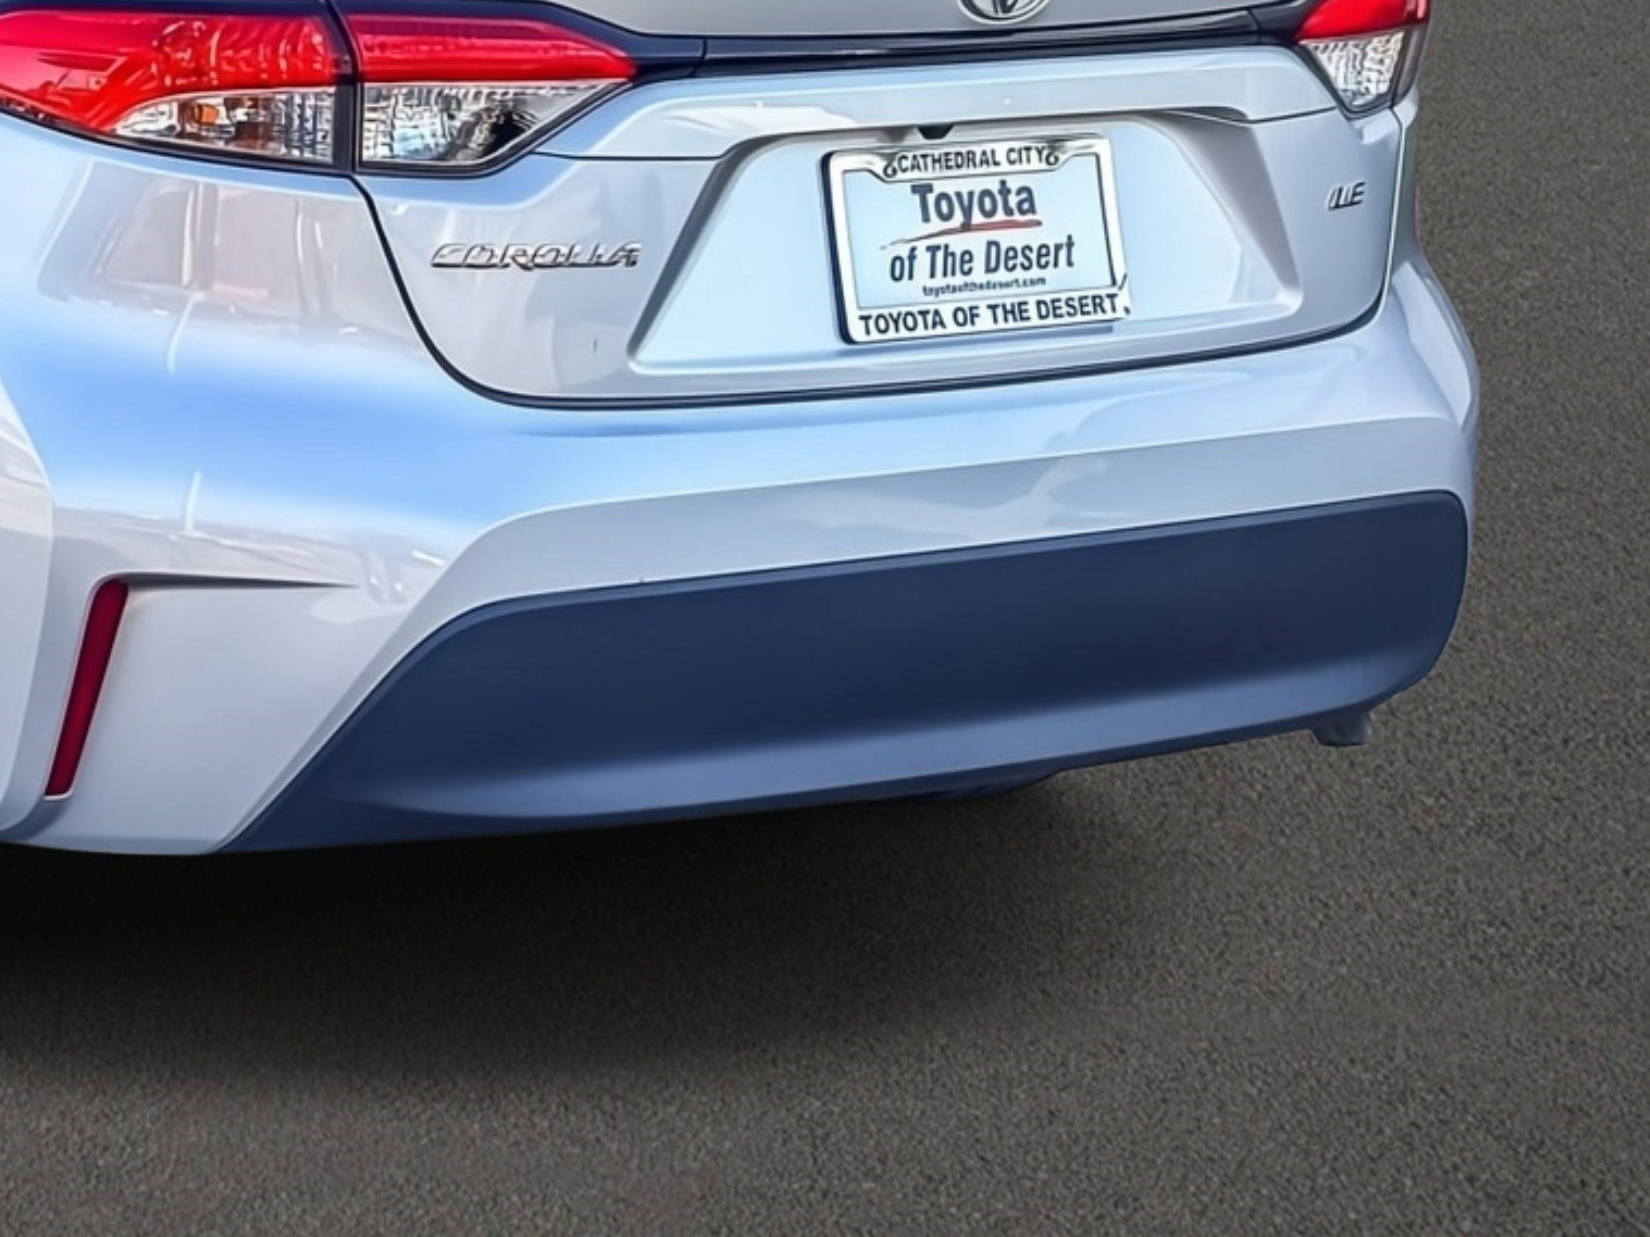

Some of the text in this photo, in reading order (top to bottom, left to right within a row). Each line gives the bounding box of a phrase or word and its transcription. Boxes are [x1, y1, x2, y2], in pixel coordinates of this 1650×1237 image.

[897, 145, 1047, 174] CATHEDRAL CITY
[910, 179, 1038, 229] Toyota
[430, 242, 642, 272] COROLLA
[889, 234, 1075, 283] of The Desert
[858, 292, 1120, 337] TOYOTA OF THE DESERT
